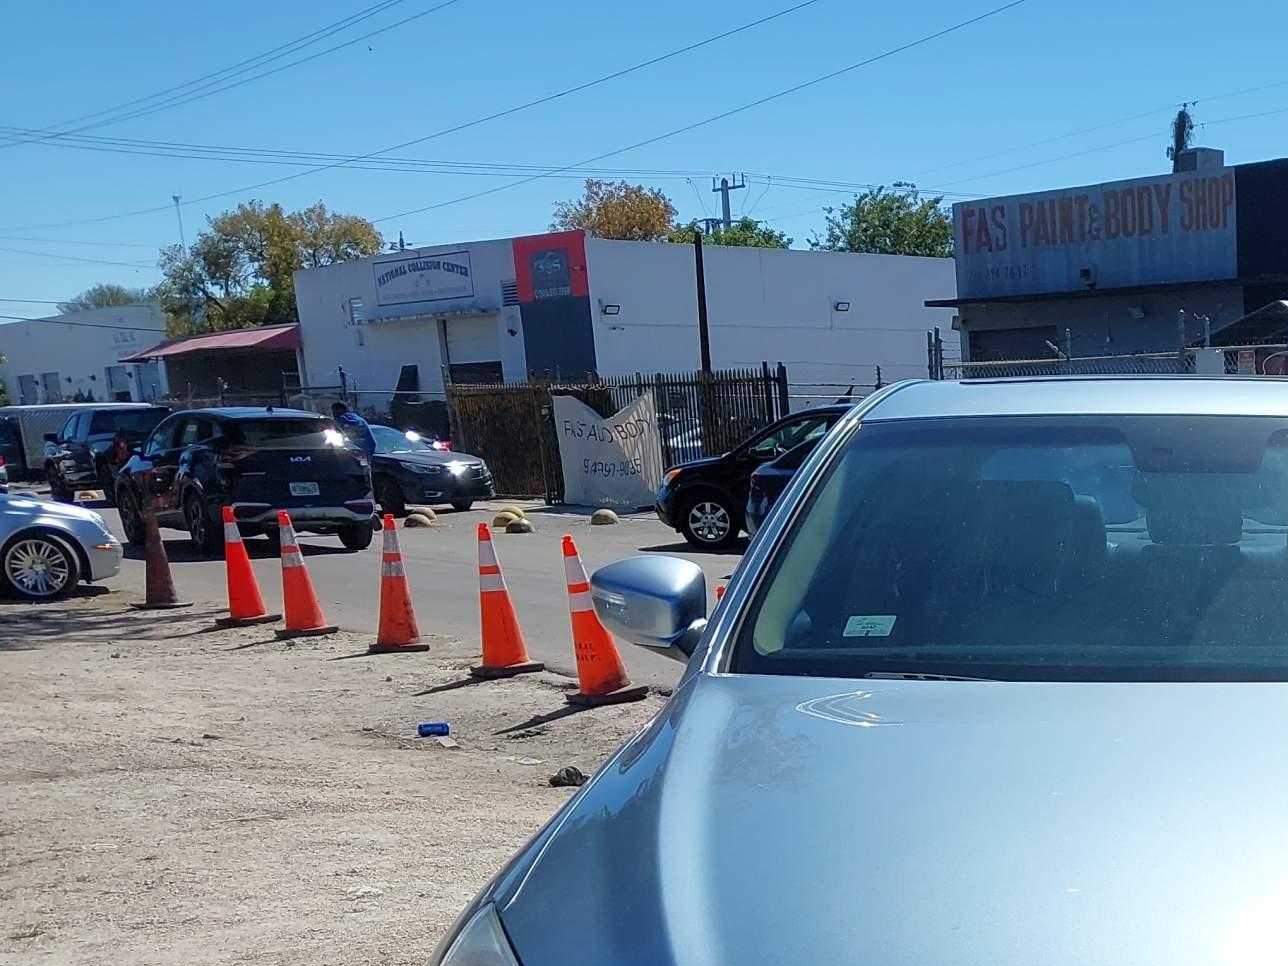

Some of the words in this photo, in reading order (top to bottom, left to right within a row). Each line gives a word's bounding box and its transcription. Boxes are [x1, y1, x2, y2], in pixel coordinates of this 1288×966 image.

[961, 205, 1007, 254] FAS
[1179, 174, 1234, 232] SHOP
[377, 264, 407, 288] NATIONAL
[407, 260, 440, 273] COLLISION
[442, 261, 469, 277] CENTER
